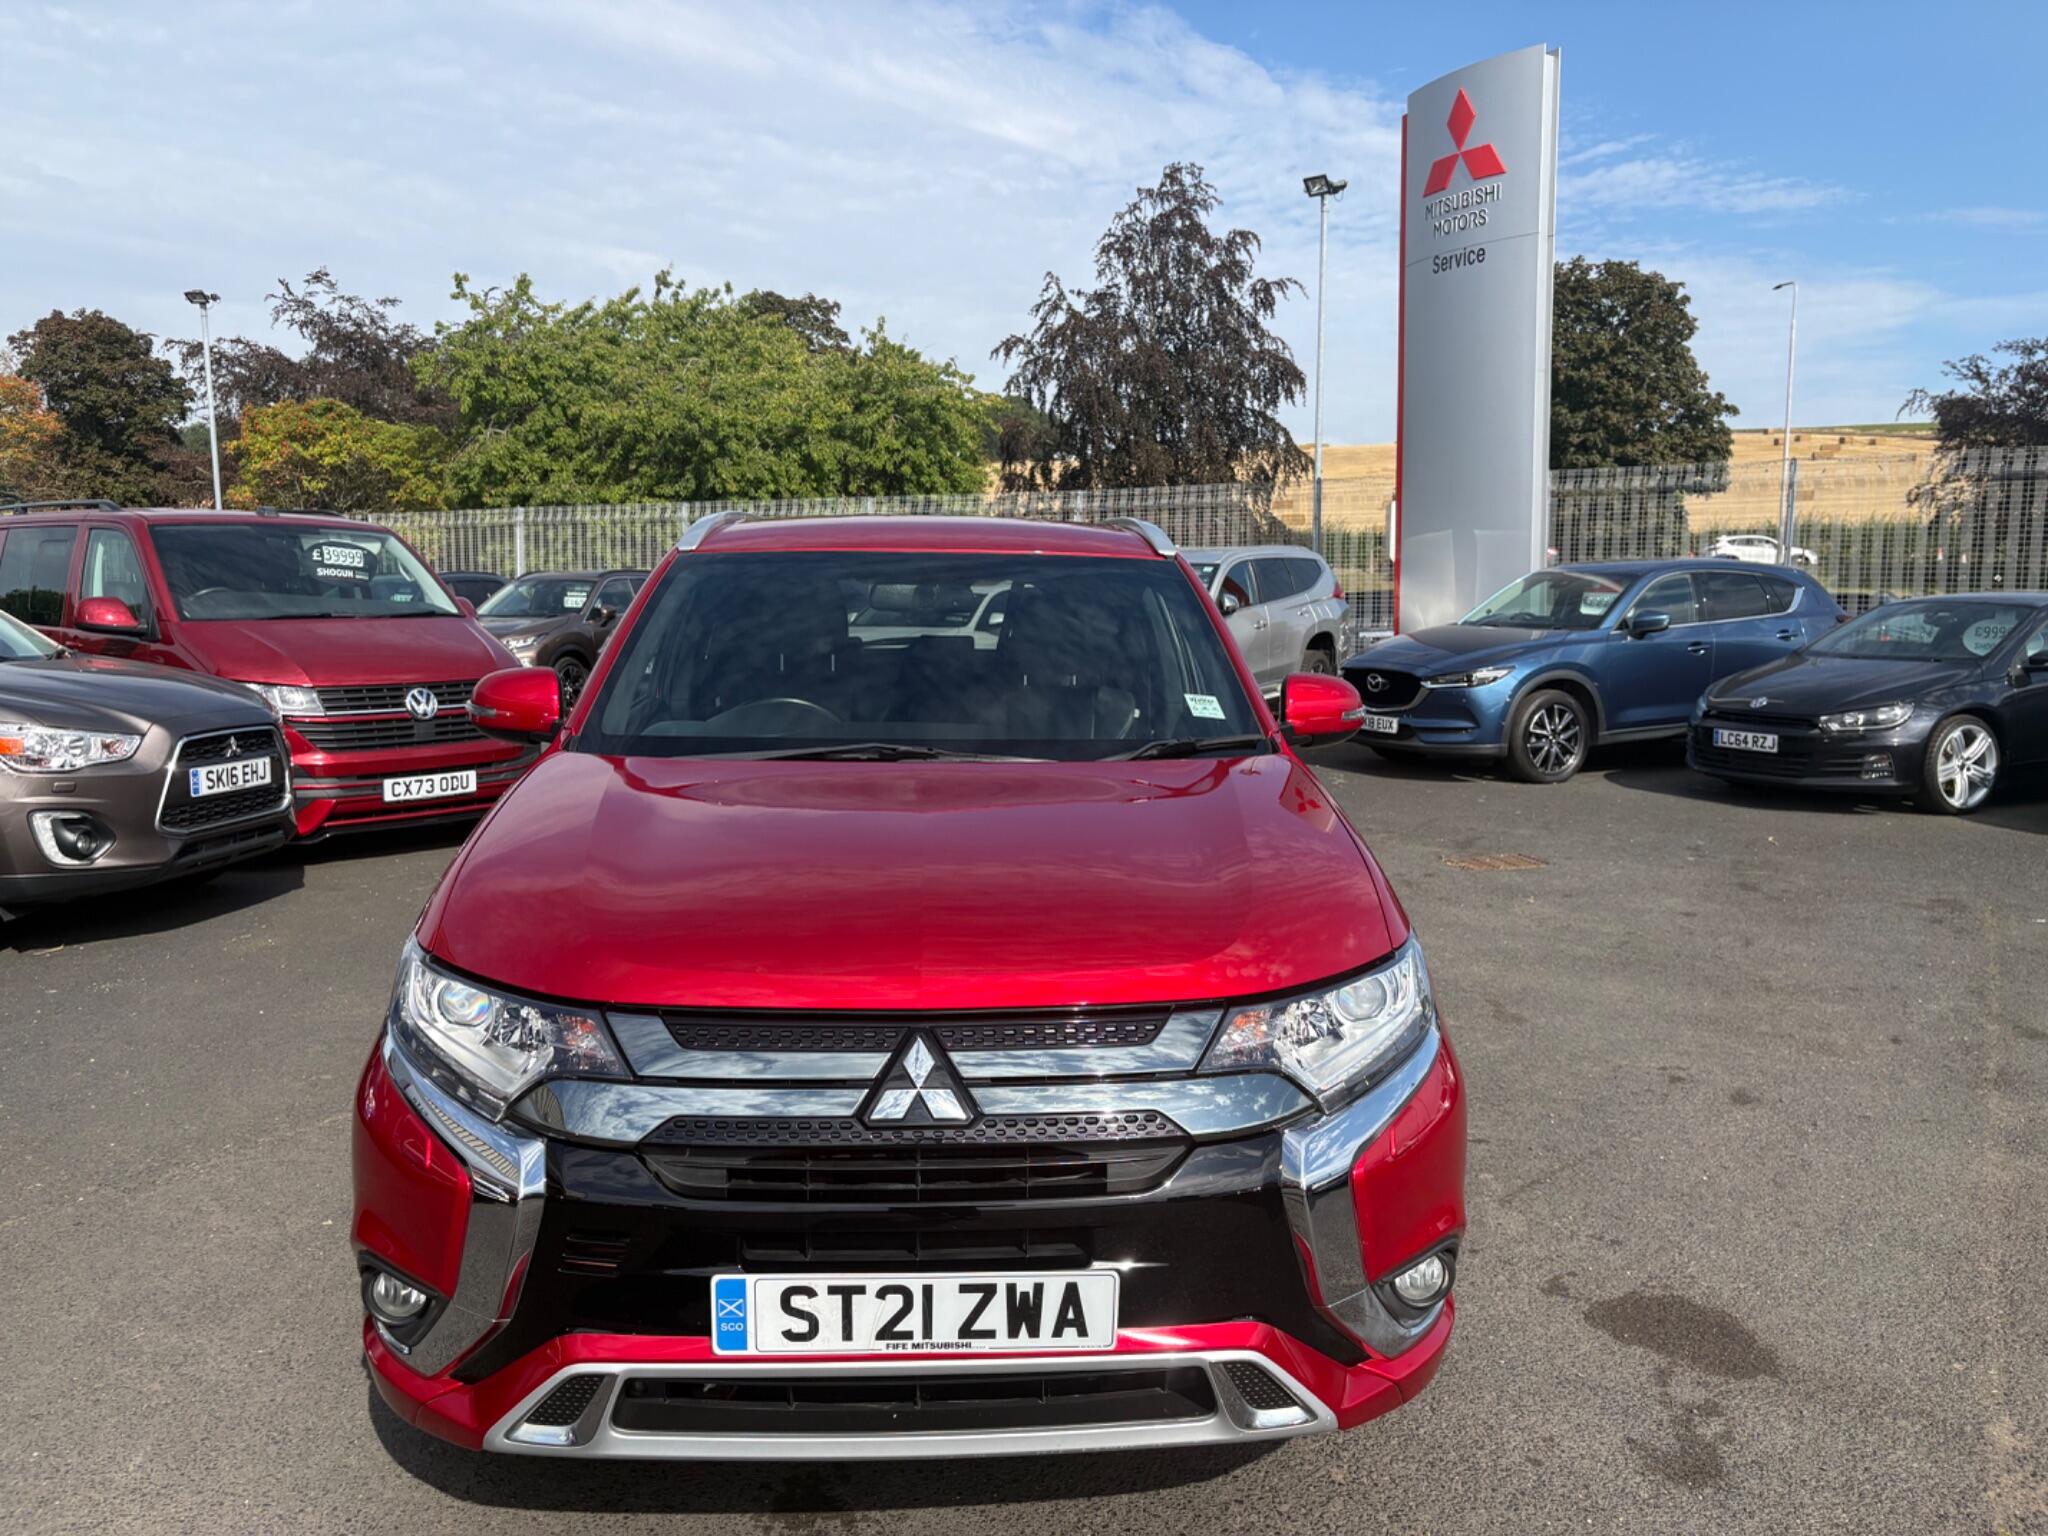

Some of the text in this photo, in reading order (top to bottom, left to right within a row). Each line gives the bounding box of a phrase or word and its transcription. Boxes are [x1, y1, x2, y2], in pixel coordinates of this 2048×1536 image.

[1425, 183, 1503, 221] MITSUBISHI
[1433, 209, 1489, 240] MOTORS
[1432, 247, 1486, 274] Service
[316, 567, 354, 578] SHOGUN
[1376, 717, 1394, 731] EUX
[1720, 731, 1776, 750] LC64 RZJ
[206, 760, 266, 790] SK16 EHJ
[391, 778, 435, 798] CX73
[780, 1281, 1089, 1343] ST21 ZWA
[720, 1322, 744, 1332] SCO
[886, 1342, 908, 1351] FIFE
[911, 1340, 973, 1350] MITSUBISHI
